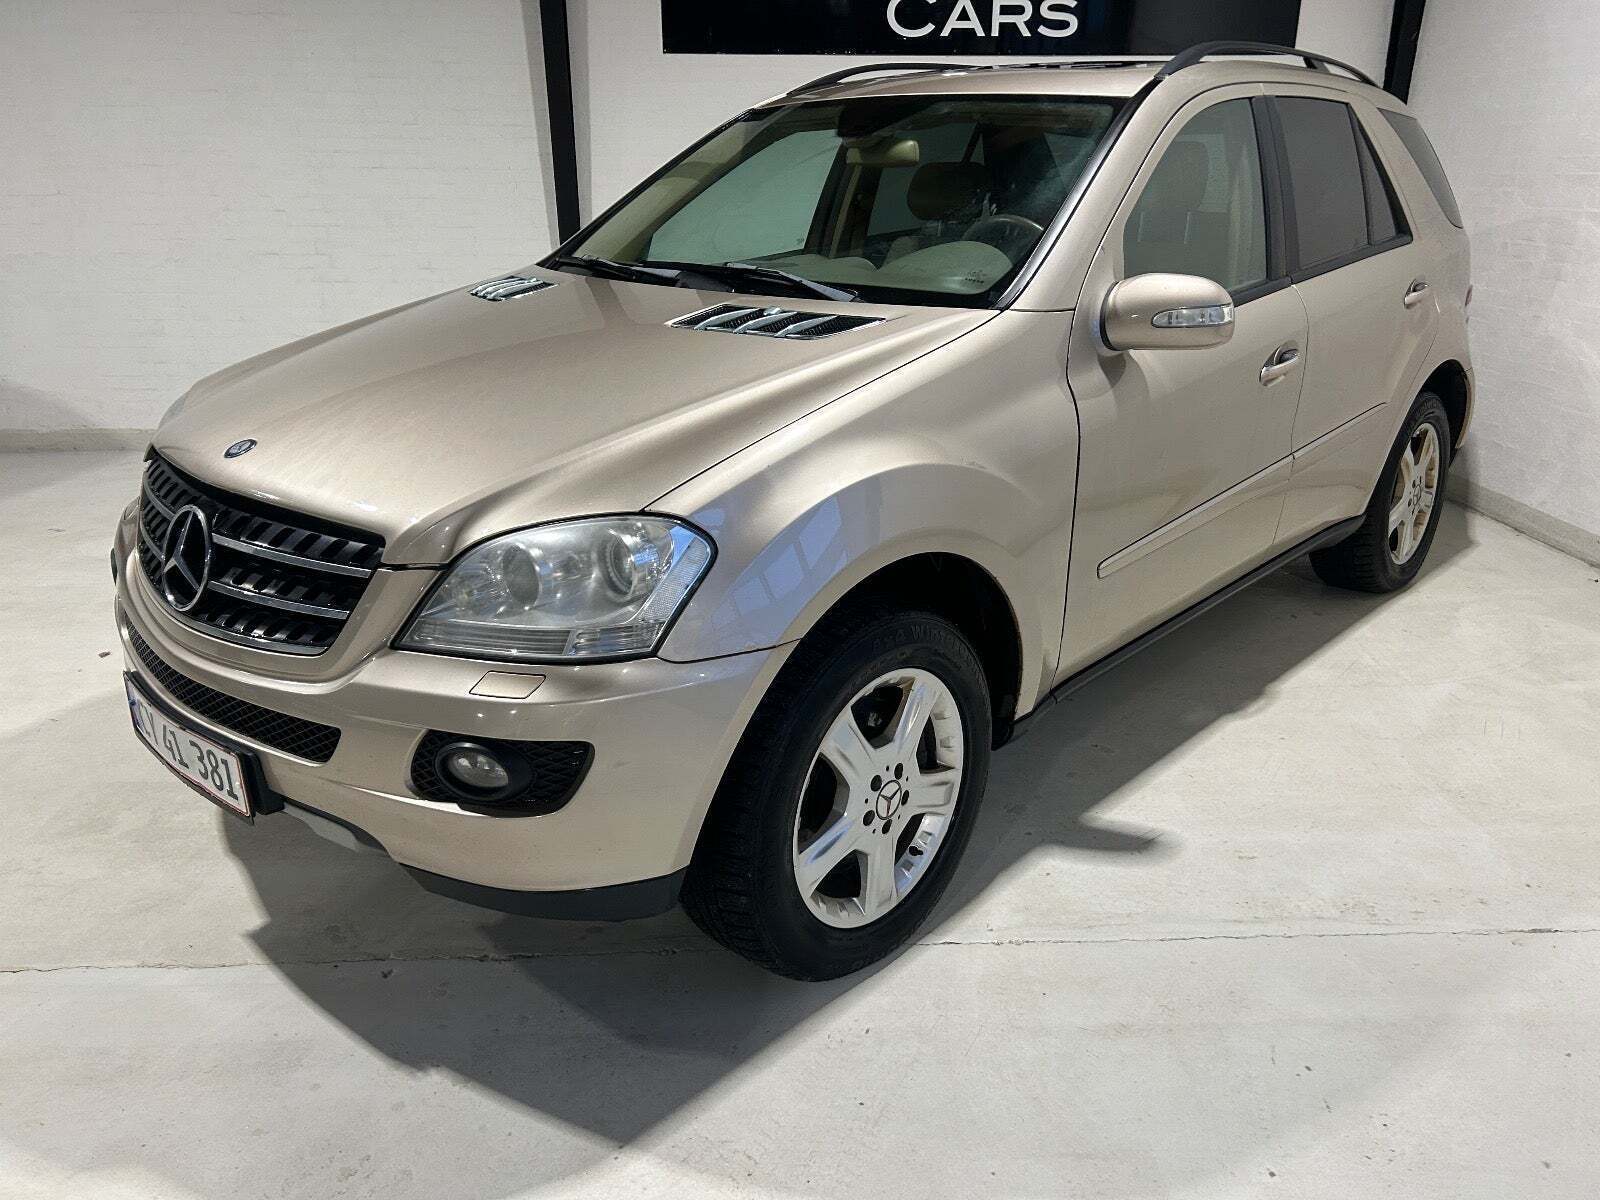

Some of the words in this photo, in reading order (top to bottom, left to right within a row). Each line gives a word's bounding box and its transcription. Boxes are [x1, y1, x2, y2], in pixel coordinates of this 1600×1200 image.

[886, 0, 1078, 38] CARS
[162, 724, 189, 770] 41
[189, 739, 239, 801] 381
